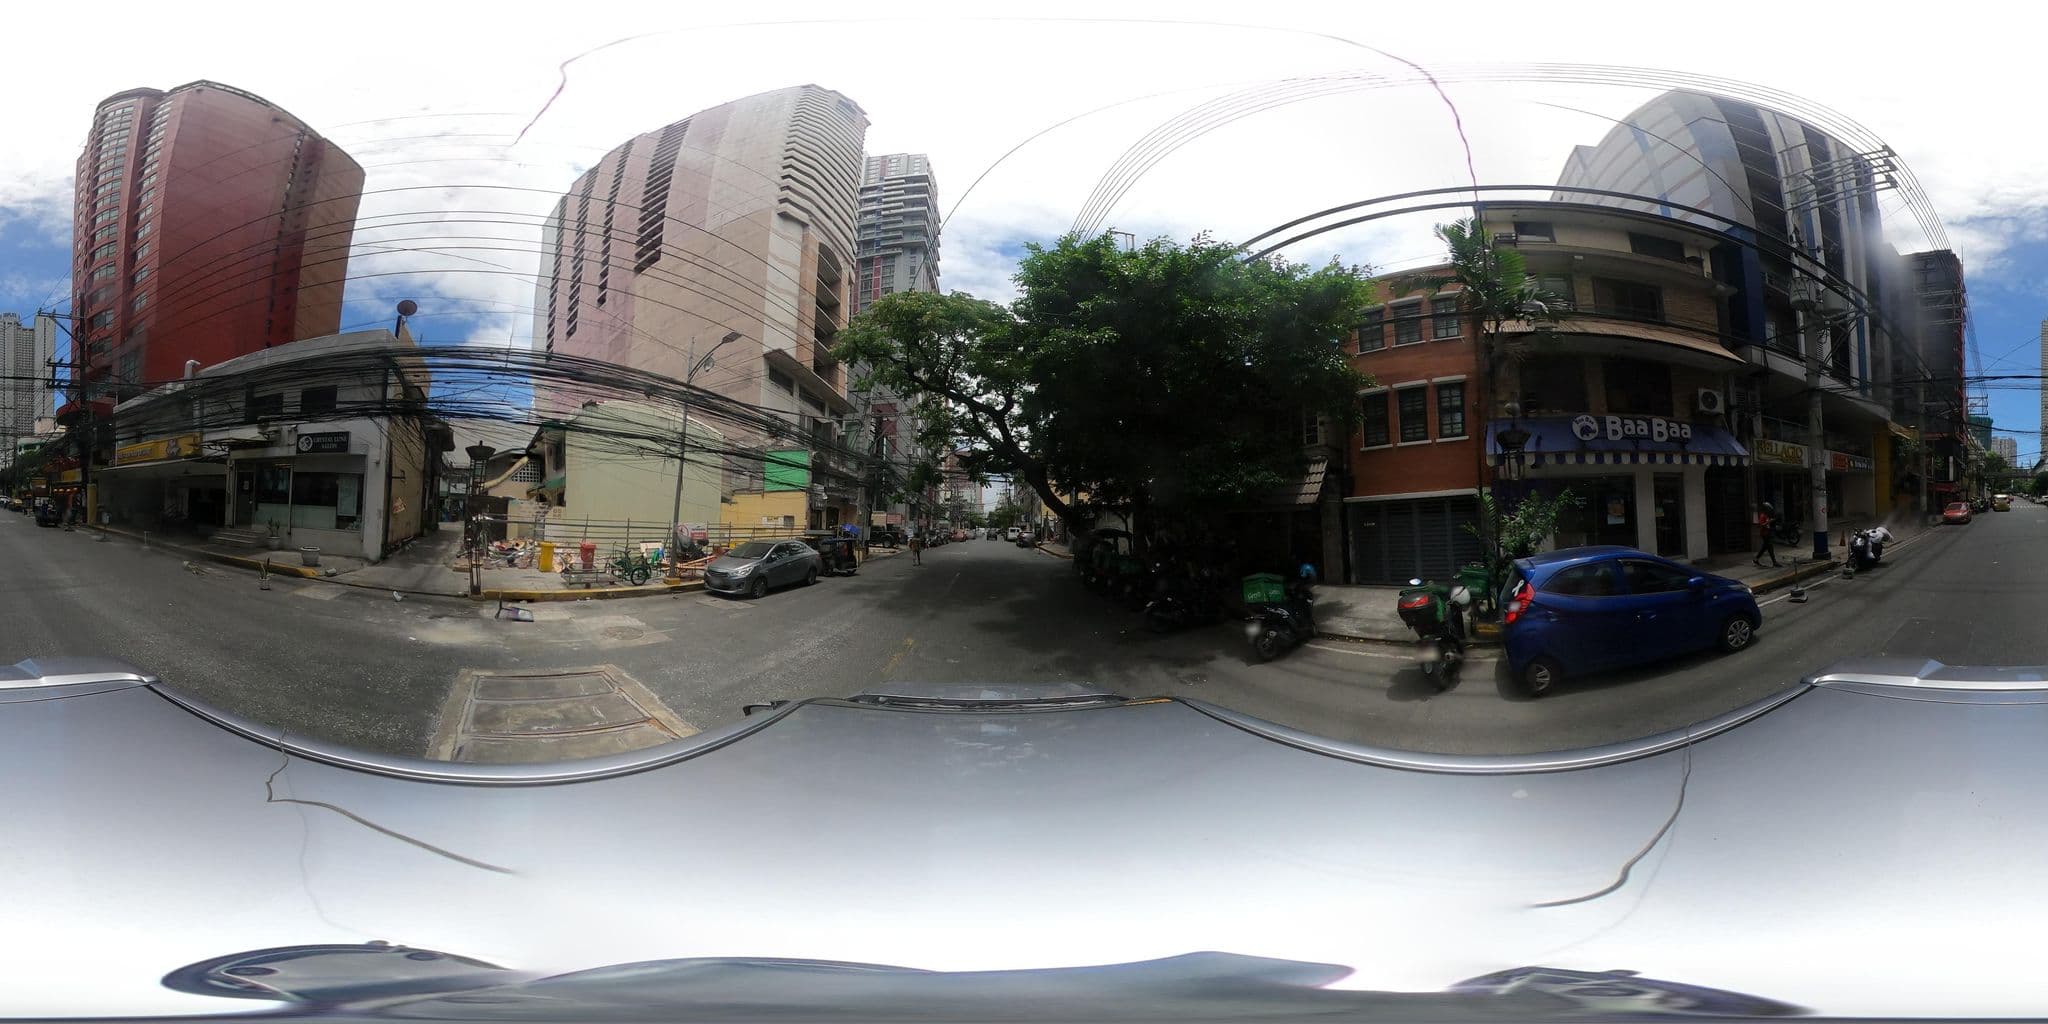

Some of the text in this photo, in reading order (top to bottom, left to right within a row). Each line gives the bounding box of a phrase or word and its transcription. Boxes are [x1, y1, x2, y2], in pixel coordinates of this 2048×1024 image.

[1606, 416, 1691, 442] Baa Baa
[1758, 440, 1803, 458] BELLAGIO
